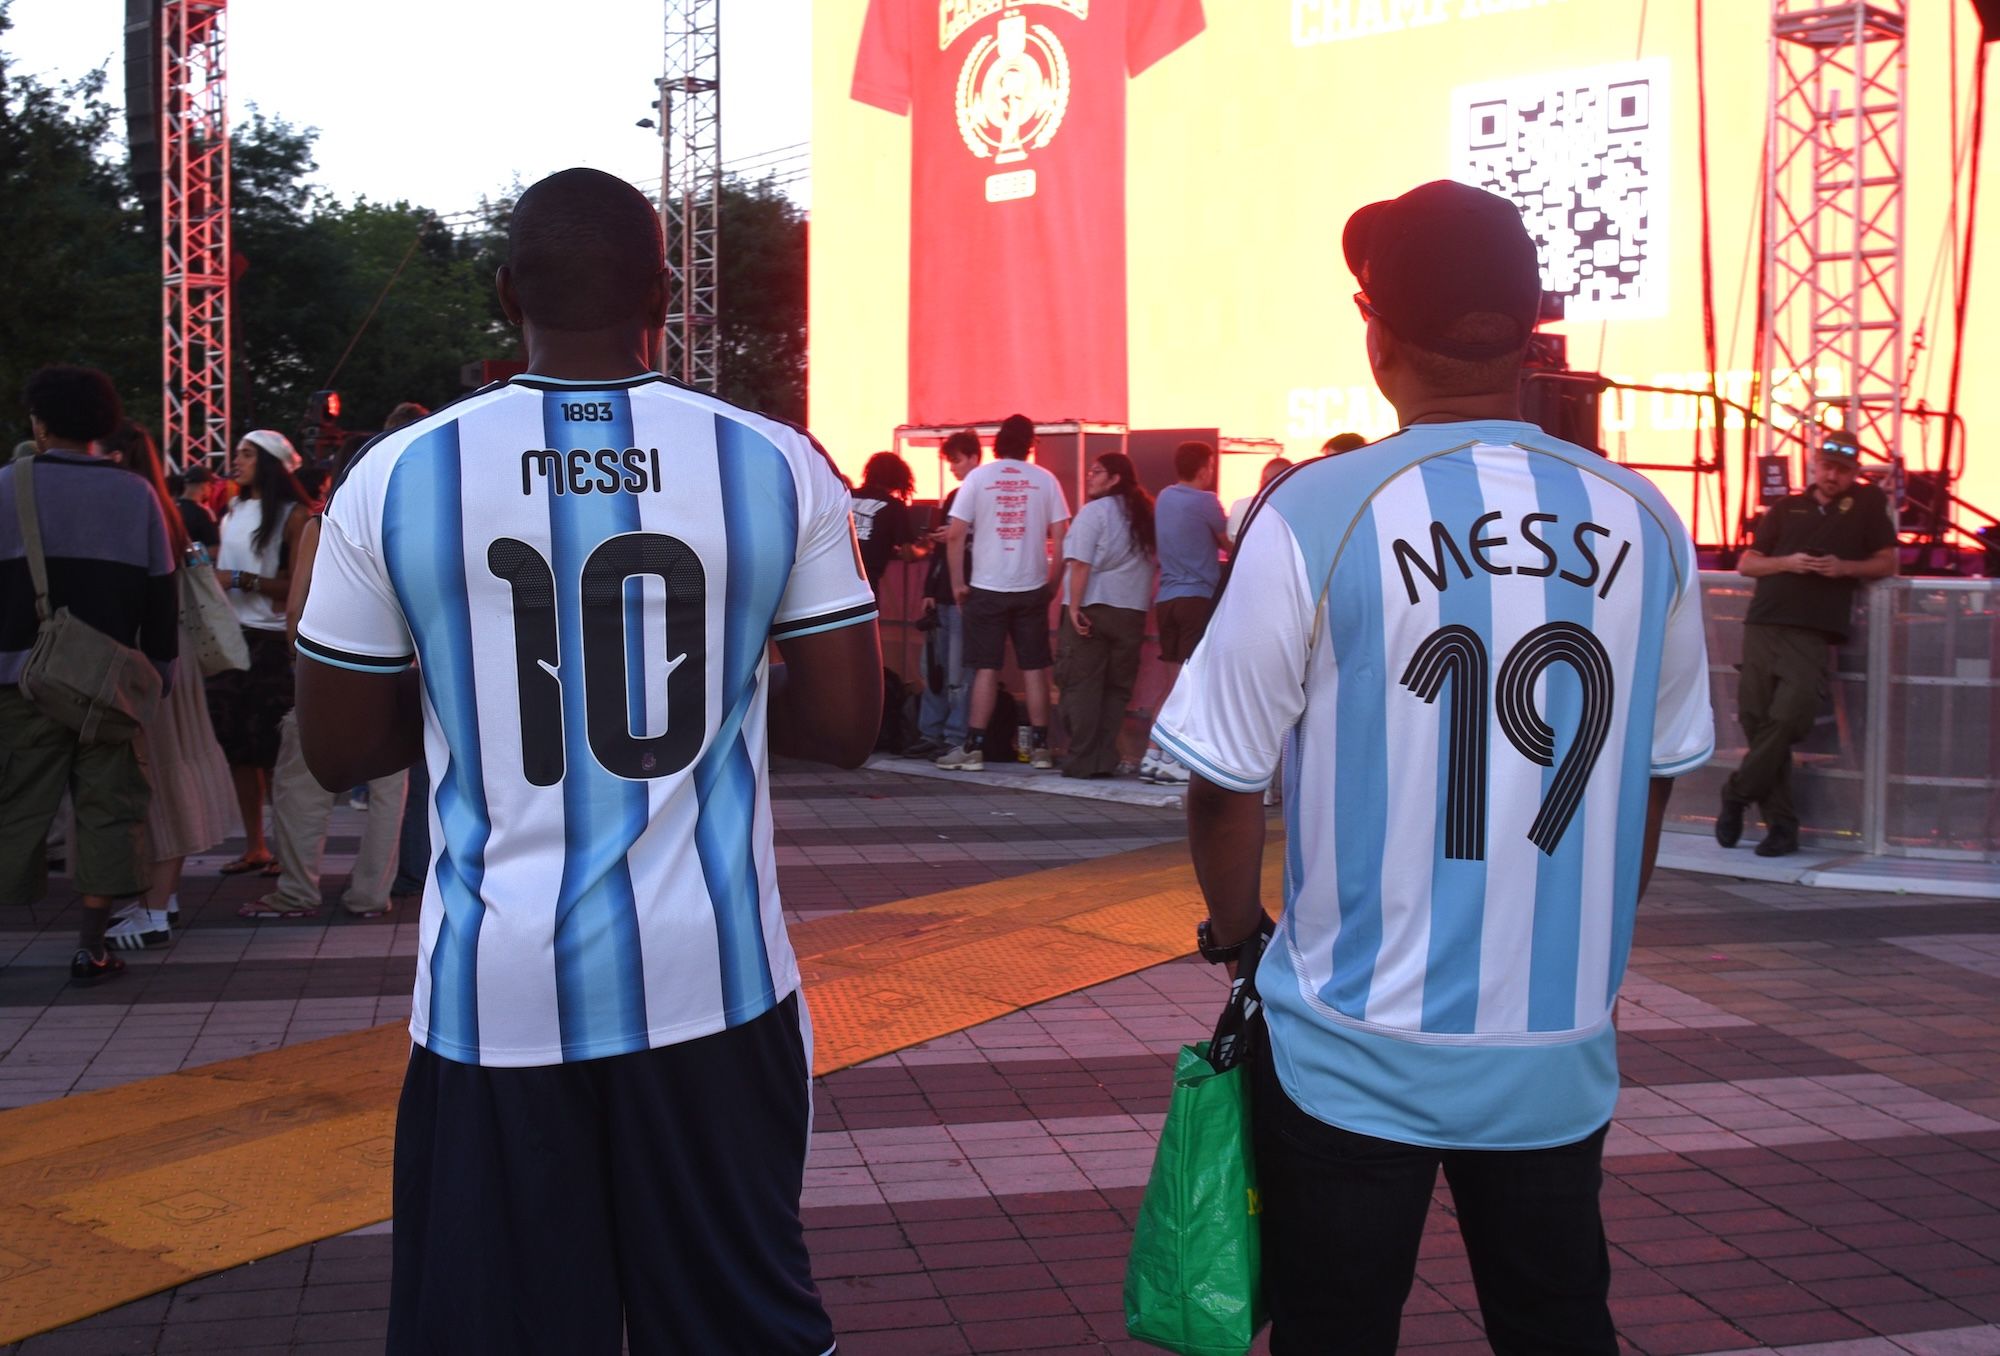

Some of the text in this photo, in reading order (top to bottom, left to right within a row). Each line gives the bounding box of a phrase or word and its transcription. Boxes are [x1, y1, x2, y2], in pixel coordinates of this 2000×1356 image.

[561, 402, 614, 422] 1893
[521, 447, 661, 497] MESSI
[1393, 511, 1632, 606] MESSI
[486, 531, 708, 788] 10
[1399, 621, 1615, 861] 19
